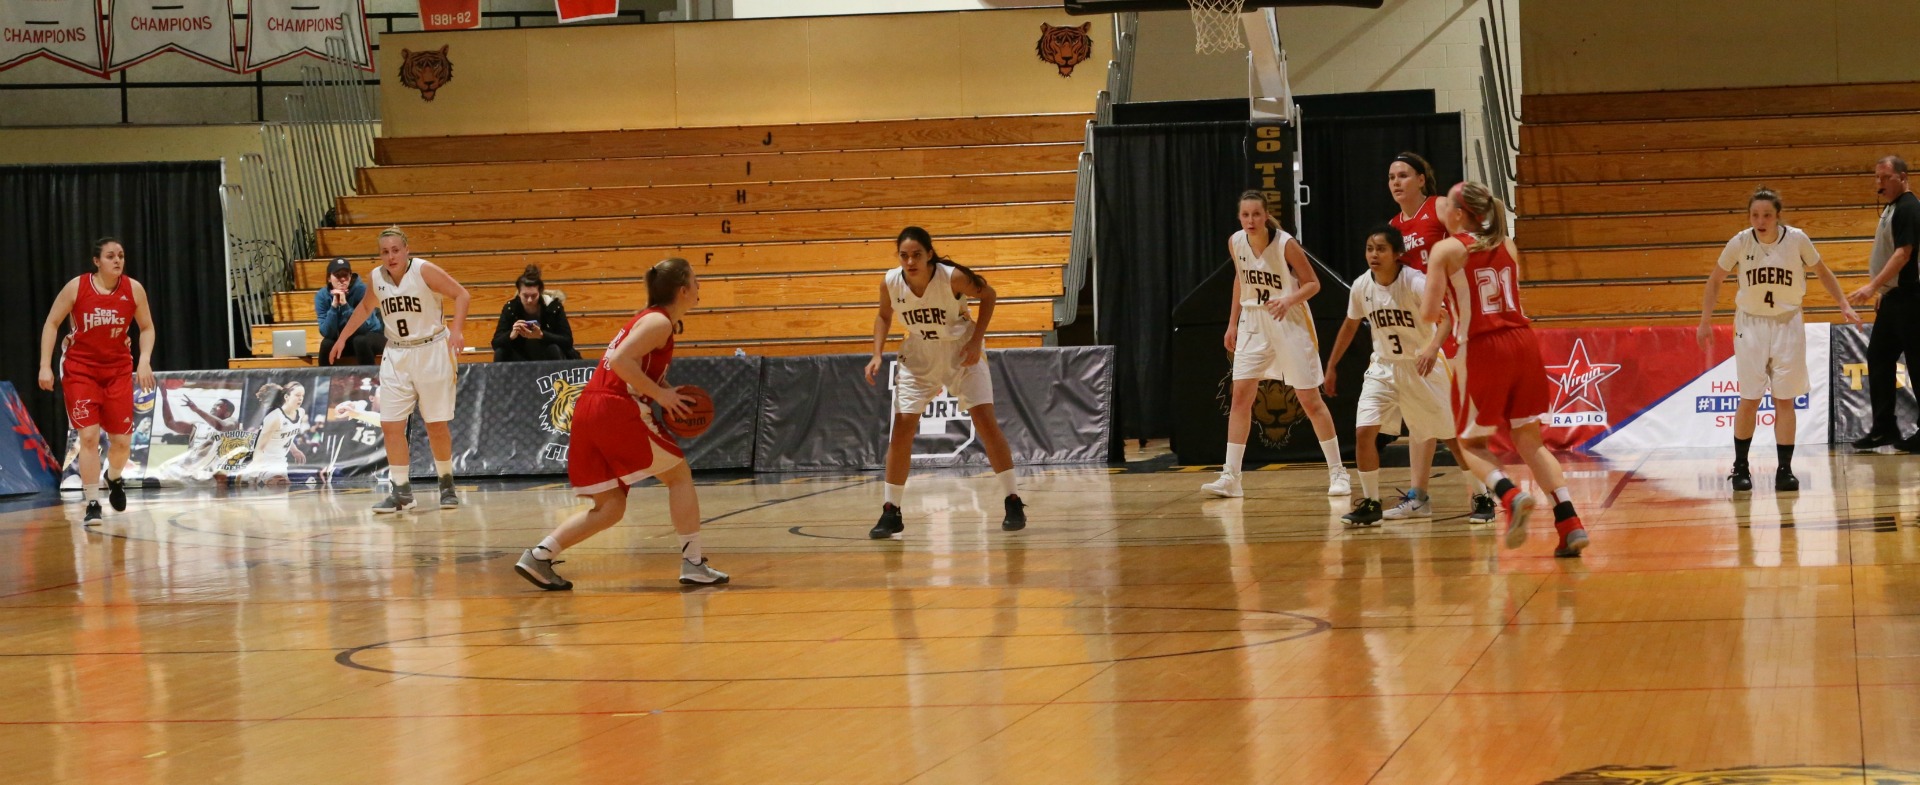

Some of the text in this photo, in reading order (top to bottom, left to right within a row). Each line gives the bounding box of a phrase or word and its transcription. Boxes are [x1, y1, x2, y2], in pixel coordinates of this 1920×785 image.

[131, 15, 212, 32] CHAMPIONS
[267, 16, 343, 33] CHAMPIONS
[430, 11, 471, 26] 1981-82
[4, 27, 86, 43] CHAMPIONS
[763, 132, 772, 146] J
[1256, 126, 1281, 152] GO
[736, 190, 746, 204] H
[721, 220, 731, 234] G
[705, 253, 713, 265] F
[1746, 266, 1793, 287] TIGERS
[1256, 288, 1270, 305] 14
[1474, 266, 1517, 315] 21
[1764, 290, 1774, 308] 4
[381, 295, 422, 316] TIGERS
[83, 313, 126, 333] Hawks
[902, 307, 946, 326] TIGERS
[1369, 308, 1415, 329] TIGERS
[396, 318, 409, 337] 8
[1388, 334, 1402, 354] 3
[1560, 359, 1601, 397] Virgin
[1698, 397, 1716, 411] #1
[1553, 414, 1603, 424] RADIO
[351, 426, 376, 446] 16
